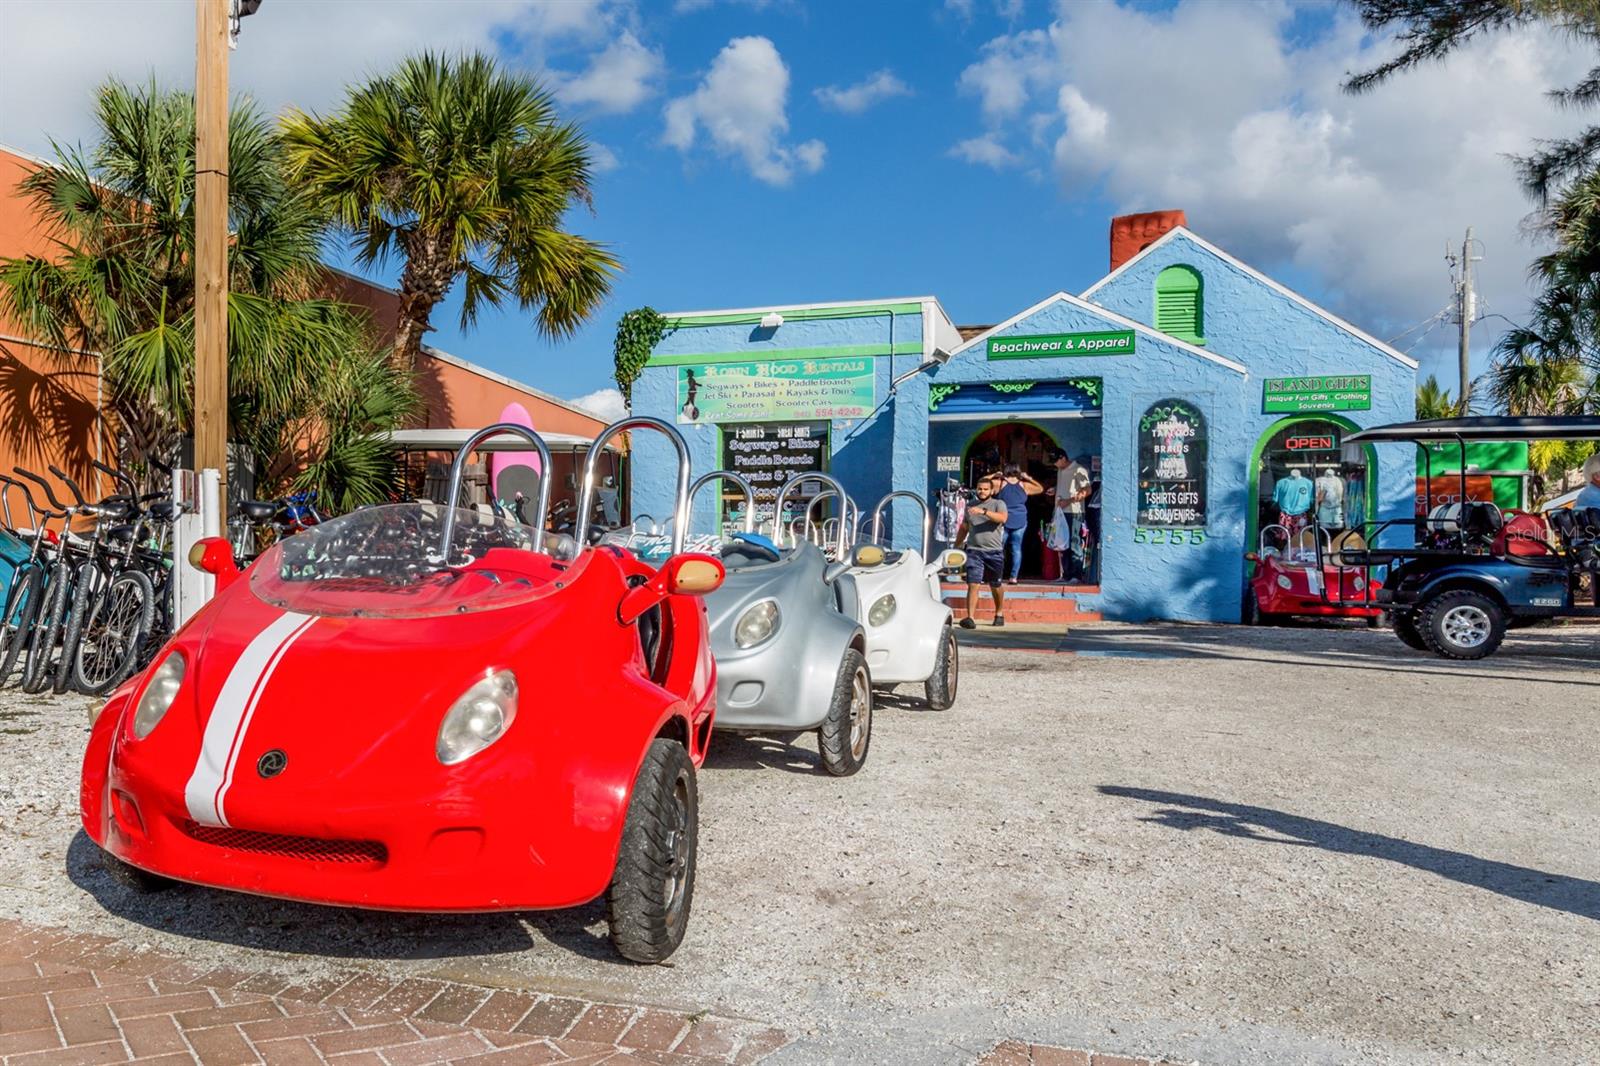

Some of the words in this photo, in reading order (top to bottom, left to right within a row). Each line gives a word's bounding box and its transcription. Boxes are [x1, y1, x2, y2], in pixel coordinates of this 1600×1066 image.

[992, 340, 1062, 353] Beachwear
[1065, 339, 1074, 350] &
[1078, 336, 1130, 350] Apparel
[706, 383, 744, 391] Segways
[1267, 379, 1322, 392] ISLAND
[1325, 377, 1368, 391] GIFTS
[718, 391, 732, 399] Ski
[742, 390, 776, 398] Parasail
[786, 389, 819, 398] Kayaks
[821, 388, 829, 396] &
[832, 387, 856, 396] Tours
[1266, 395, 1293, 403] Unique
[1311, 393, 1328, 401] Gifts
[1335, 391, 1368, 400] Clothing
[1151, 429, 1195, 437] TATTOOS
[729, 440, 779, 451] Segways
[788, 438, 820, 449] Bikes
[1154, 445, 1189, 453] BRAIDS
[1286, 438, 1331, 449] OPEN
[1145, 492, 1176, 504] T-SHIRTS
[1177, 492, 1198, 504] GIFTS
[1148, 508, 1154, 520] &
[1154, 508, 1196, 521] SOUVENIRS
[1134, 528, 1205, 545] 5255
